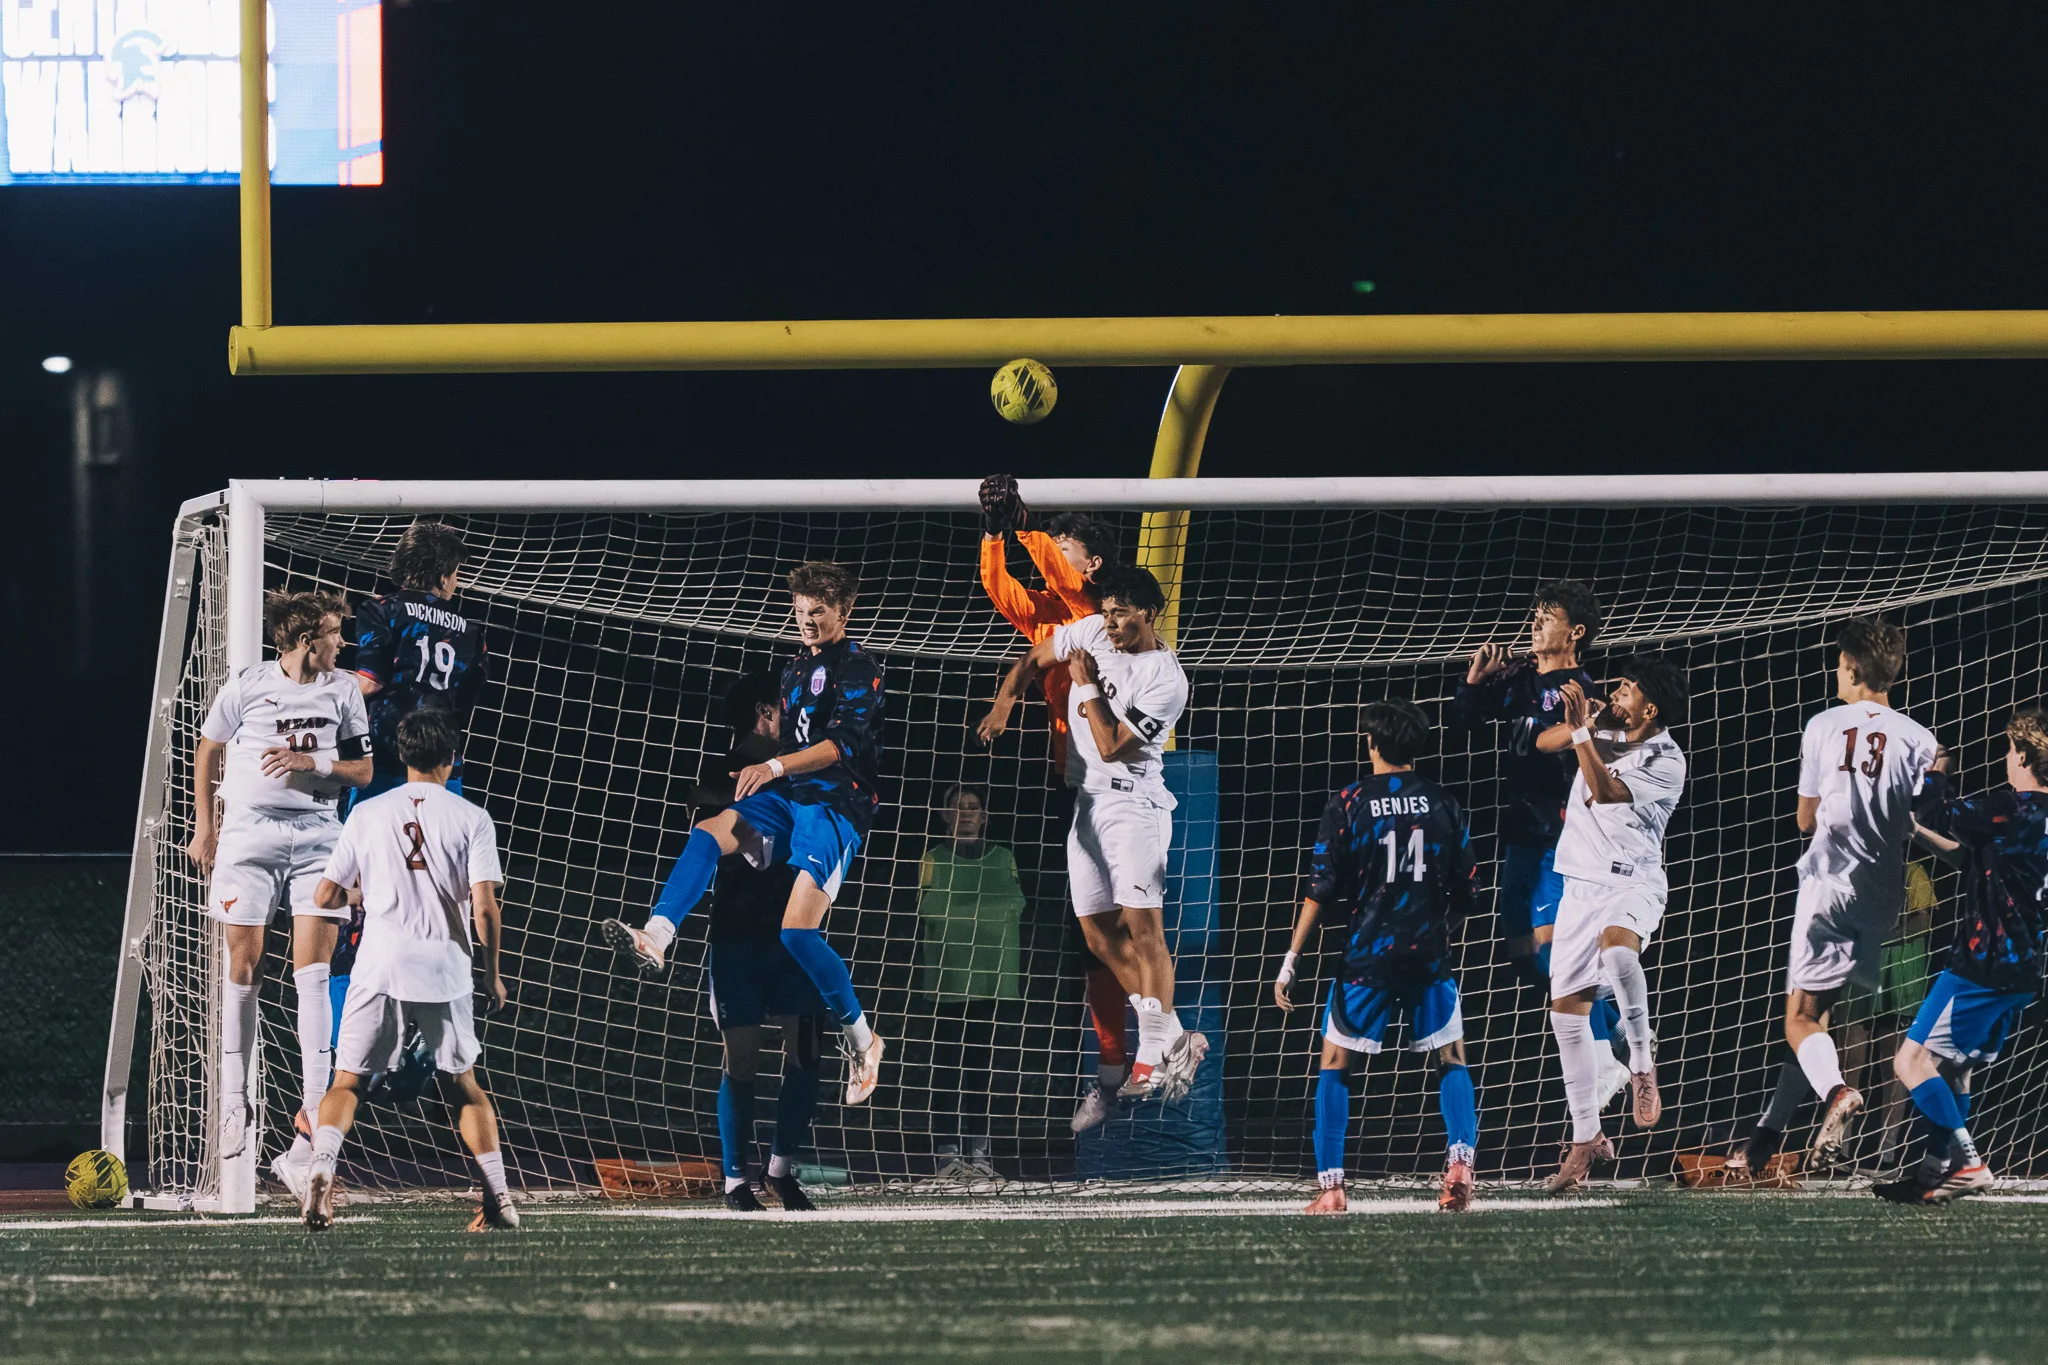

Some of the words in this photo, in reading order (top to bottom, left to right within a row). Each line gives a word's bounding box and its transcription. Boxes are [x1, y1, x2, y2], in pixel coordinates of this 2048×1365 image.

[404, 602, 467, 633] DICKINSON
[415, 635, 456, 690] 19
[1137, 716, 1158, 735] C
[286, 732, 318, 752] 10
[360, 735, 373, 752] C
[1838, 726, 1887, 778] 13
[1369, 795, 1429, 817] BENJES
[402, 821, 428, 870] 2
[1378, 829, 1427, 883] 14
